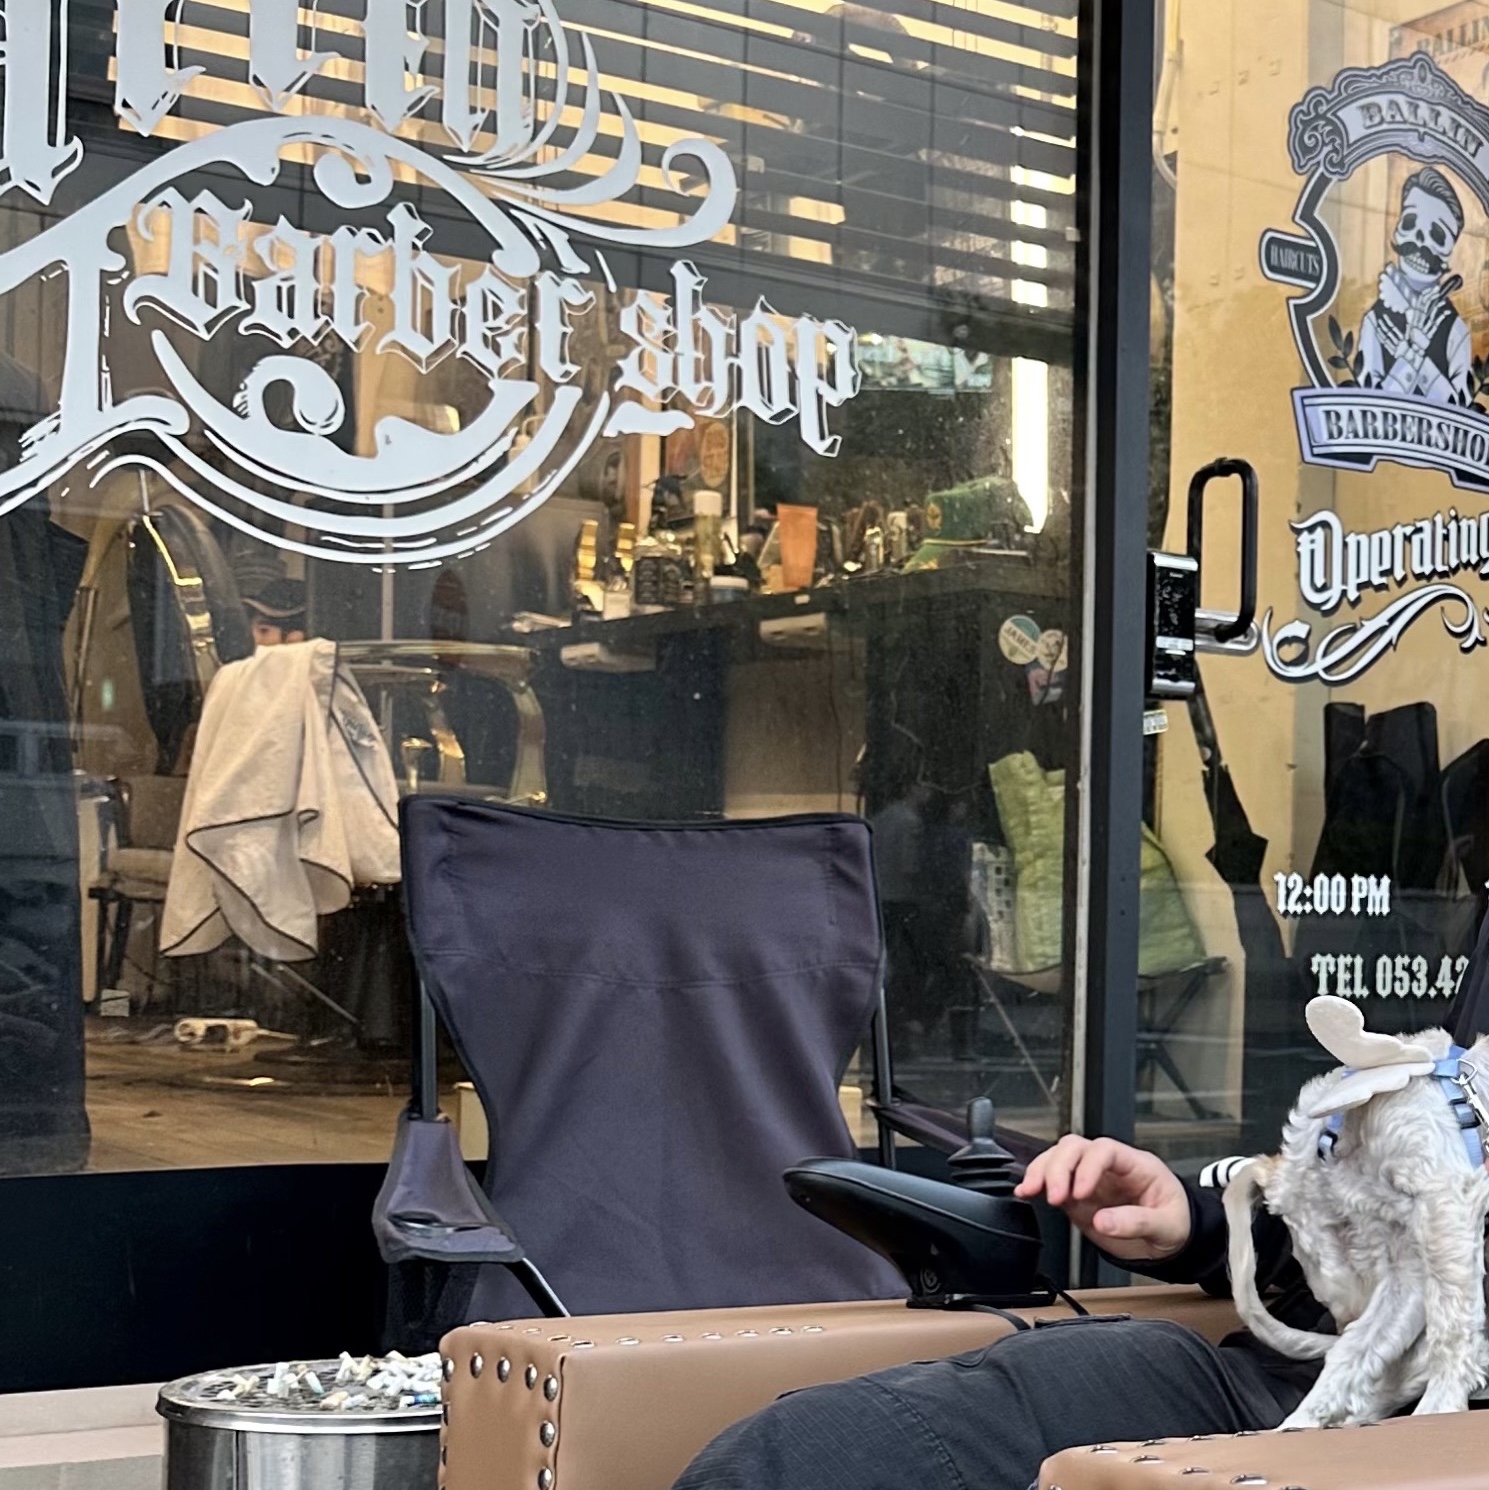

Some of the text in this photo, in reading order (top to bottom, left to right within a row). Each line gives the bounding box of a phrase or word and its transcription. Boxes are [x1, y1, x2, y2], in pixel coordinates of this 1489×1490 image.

[1356, 99, 1484, 158] BALLIN
[125, 187, 862, 457] Barber shop
[1273, 871, 1348, 916] 12:00
[1351, 872, 1392, 917] PM
[1311, 952, 1370, 998] TEL
